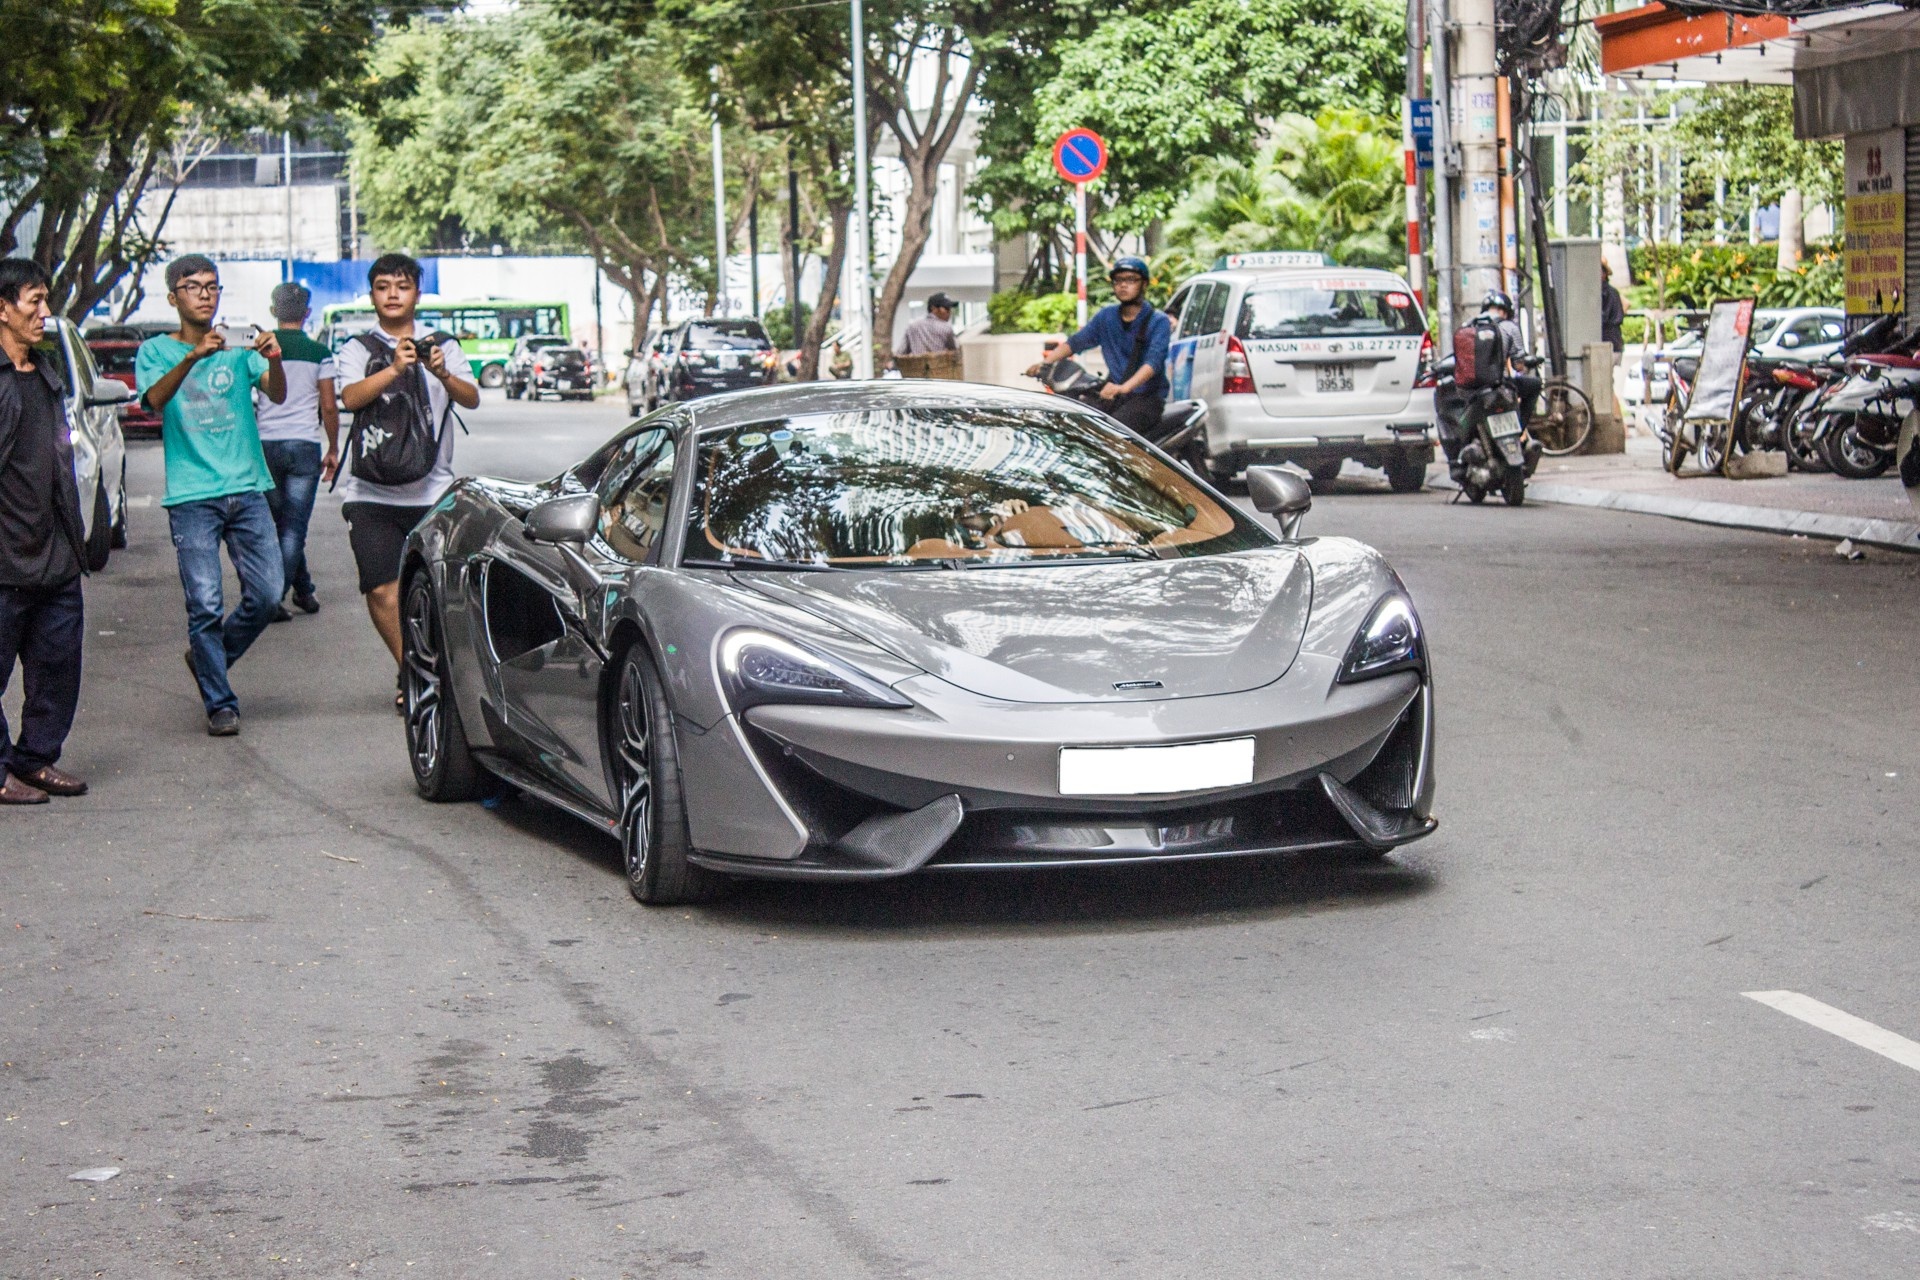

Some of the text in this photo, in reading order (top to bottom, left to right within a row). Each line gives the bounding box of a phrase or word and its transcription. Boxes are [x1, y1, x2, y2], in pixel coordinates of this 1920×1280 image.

[1287, 254, 1301, 264] 27
[1305, 254, 1319, 264] 27
[1247, 341, 1322, 353] VINASUN TAXI
[1388, 339, 1402, 350] 27
[1405, 339, 1419, 350] 27
